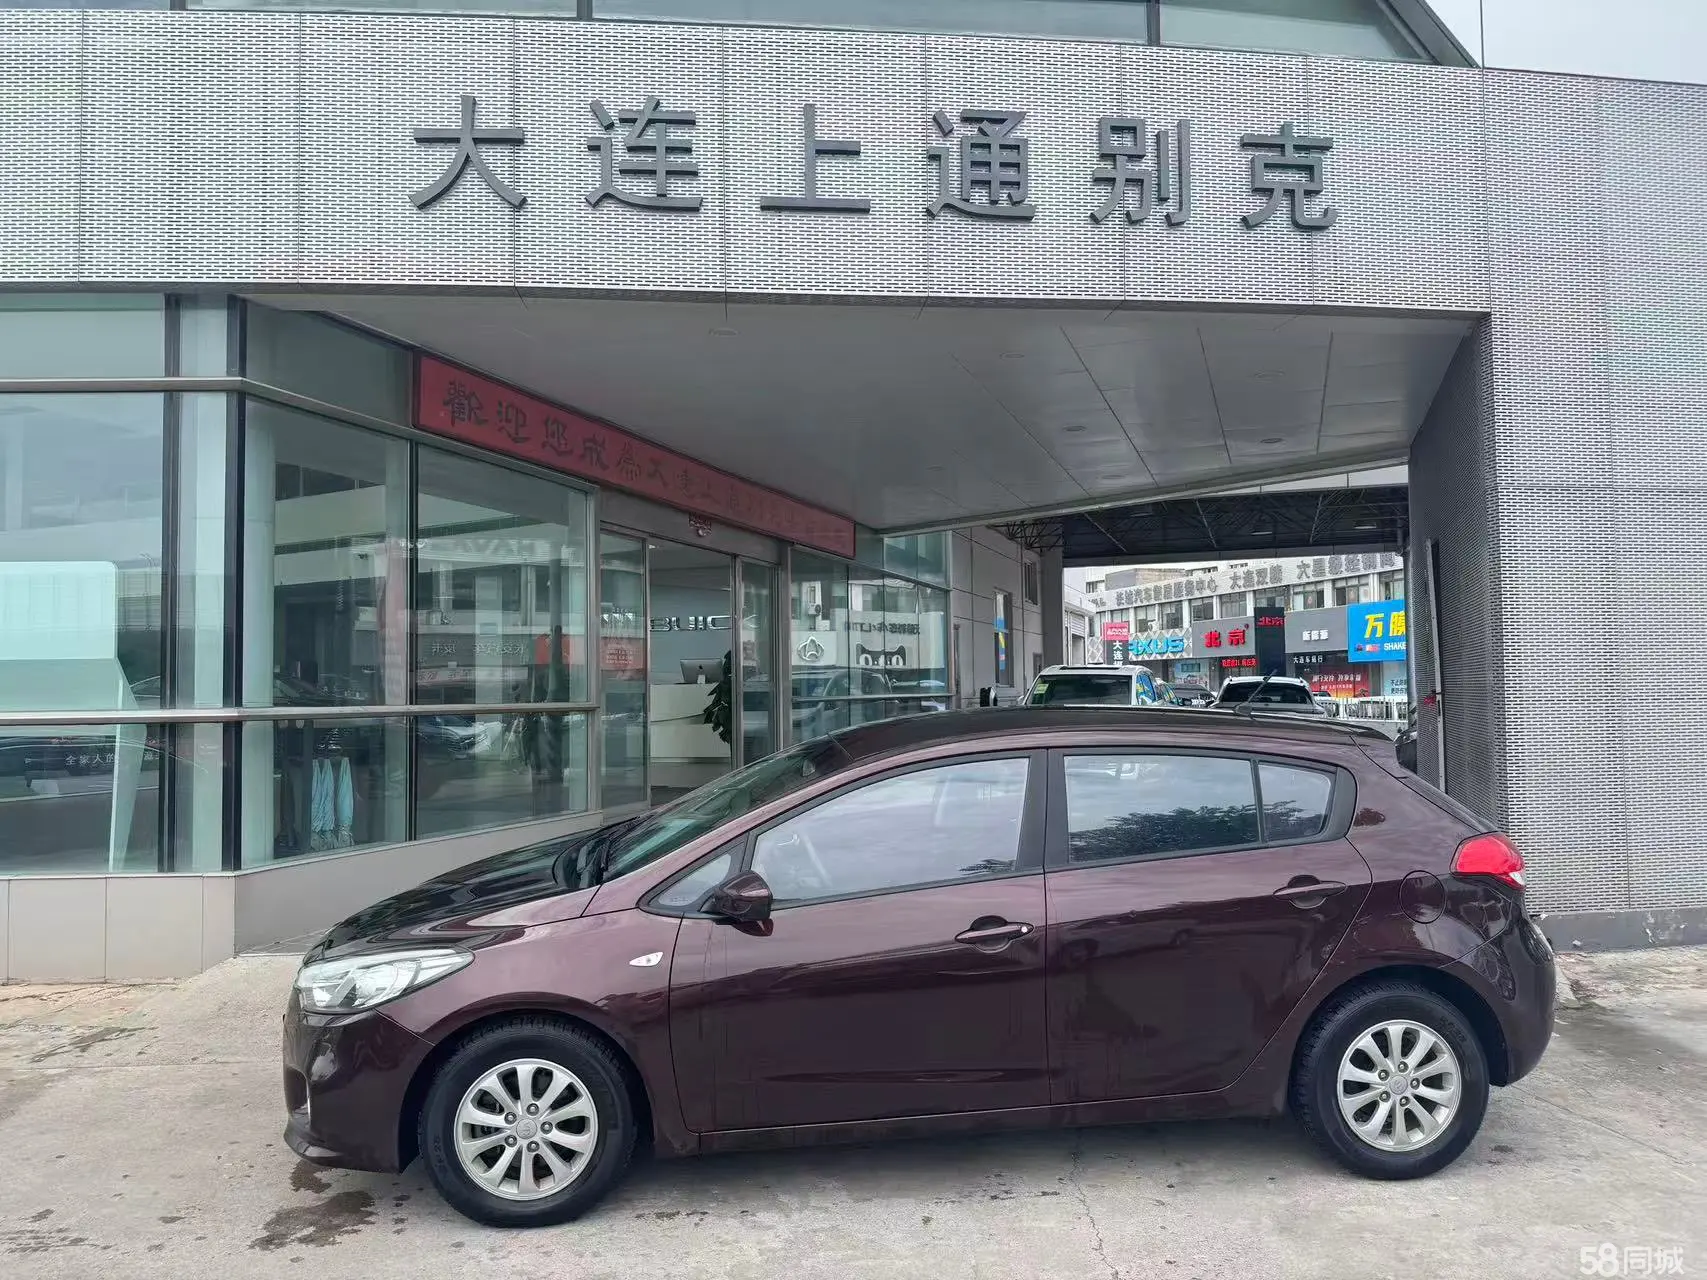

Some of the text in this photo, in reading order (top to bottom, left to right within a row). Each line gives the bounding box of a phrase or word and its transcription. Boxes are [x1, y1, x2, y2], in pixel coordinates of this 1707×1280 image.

[408, 95, 1338, 228] 大连上通别克
[1204, 628, 1246, 648] 北京
